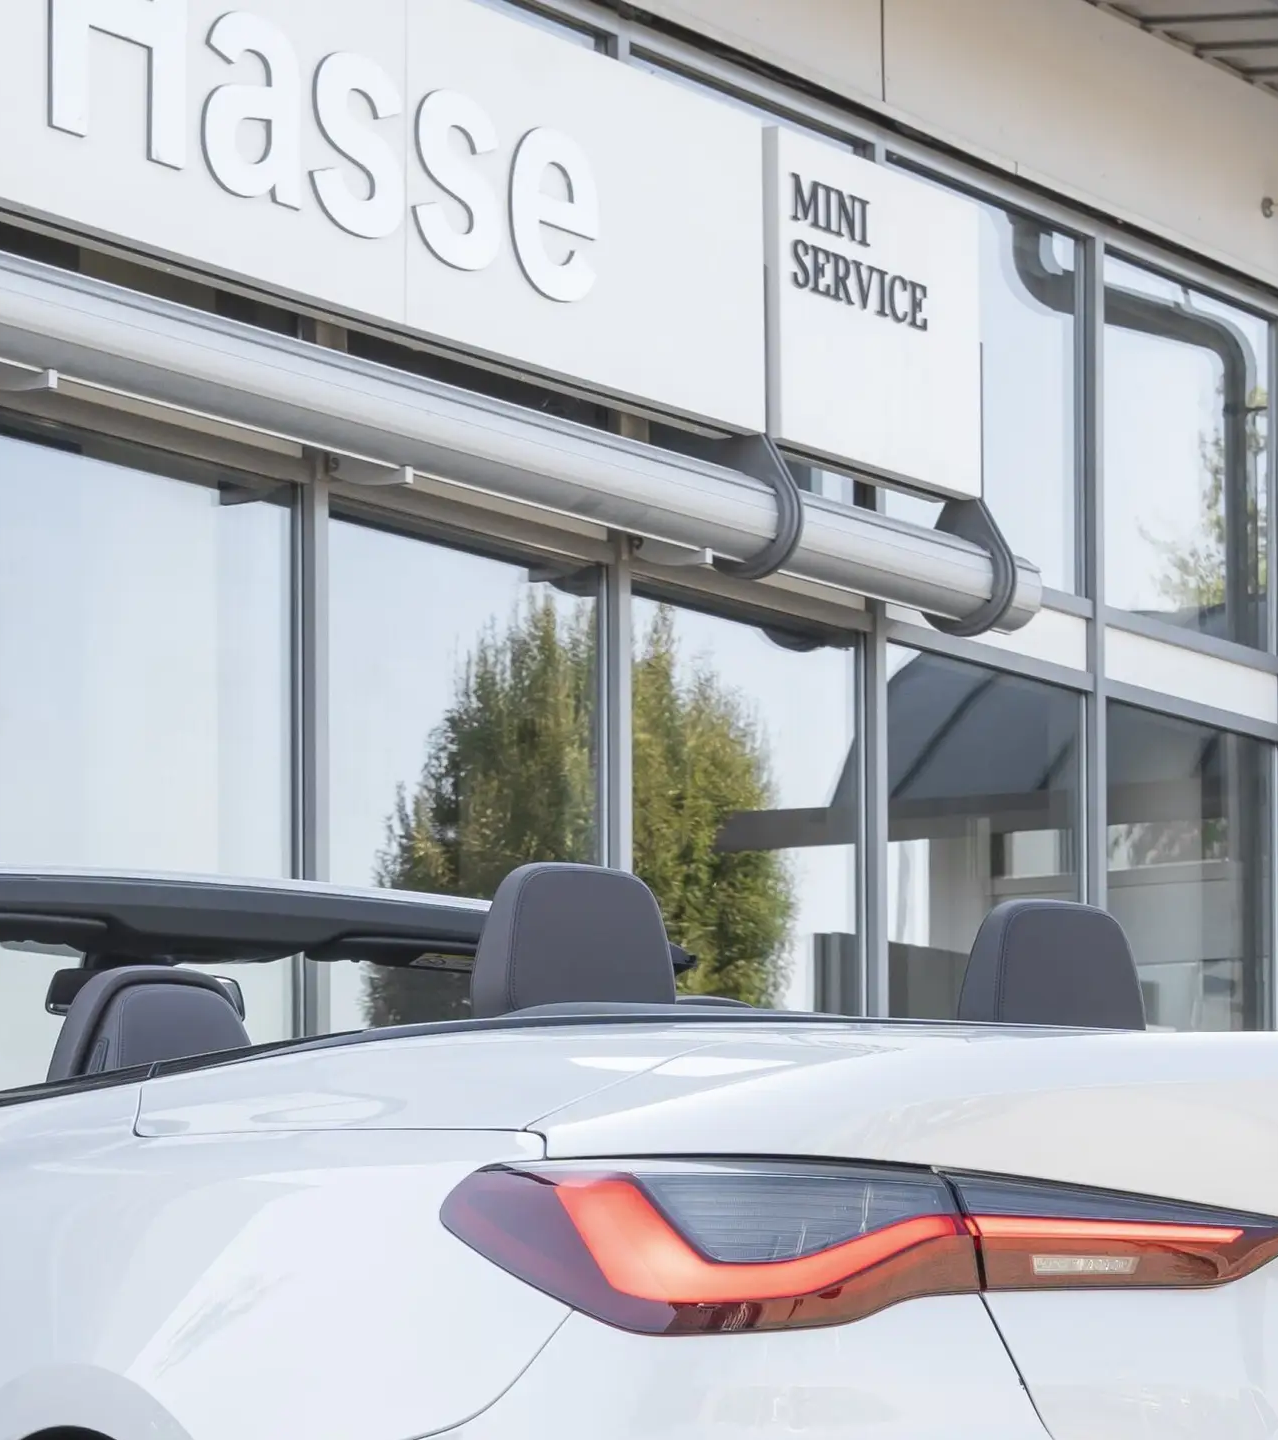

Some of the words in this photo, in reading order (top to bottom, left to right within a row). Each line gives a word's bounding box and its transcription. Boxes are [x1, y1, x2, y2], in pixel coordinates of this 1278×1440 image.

[48, 0, 598, 302] Hasse
[789, 172, 871, 247] MINI
[791, 239, 928, 331] SERVICE
